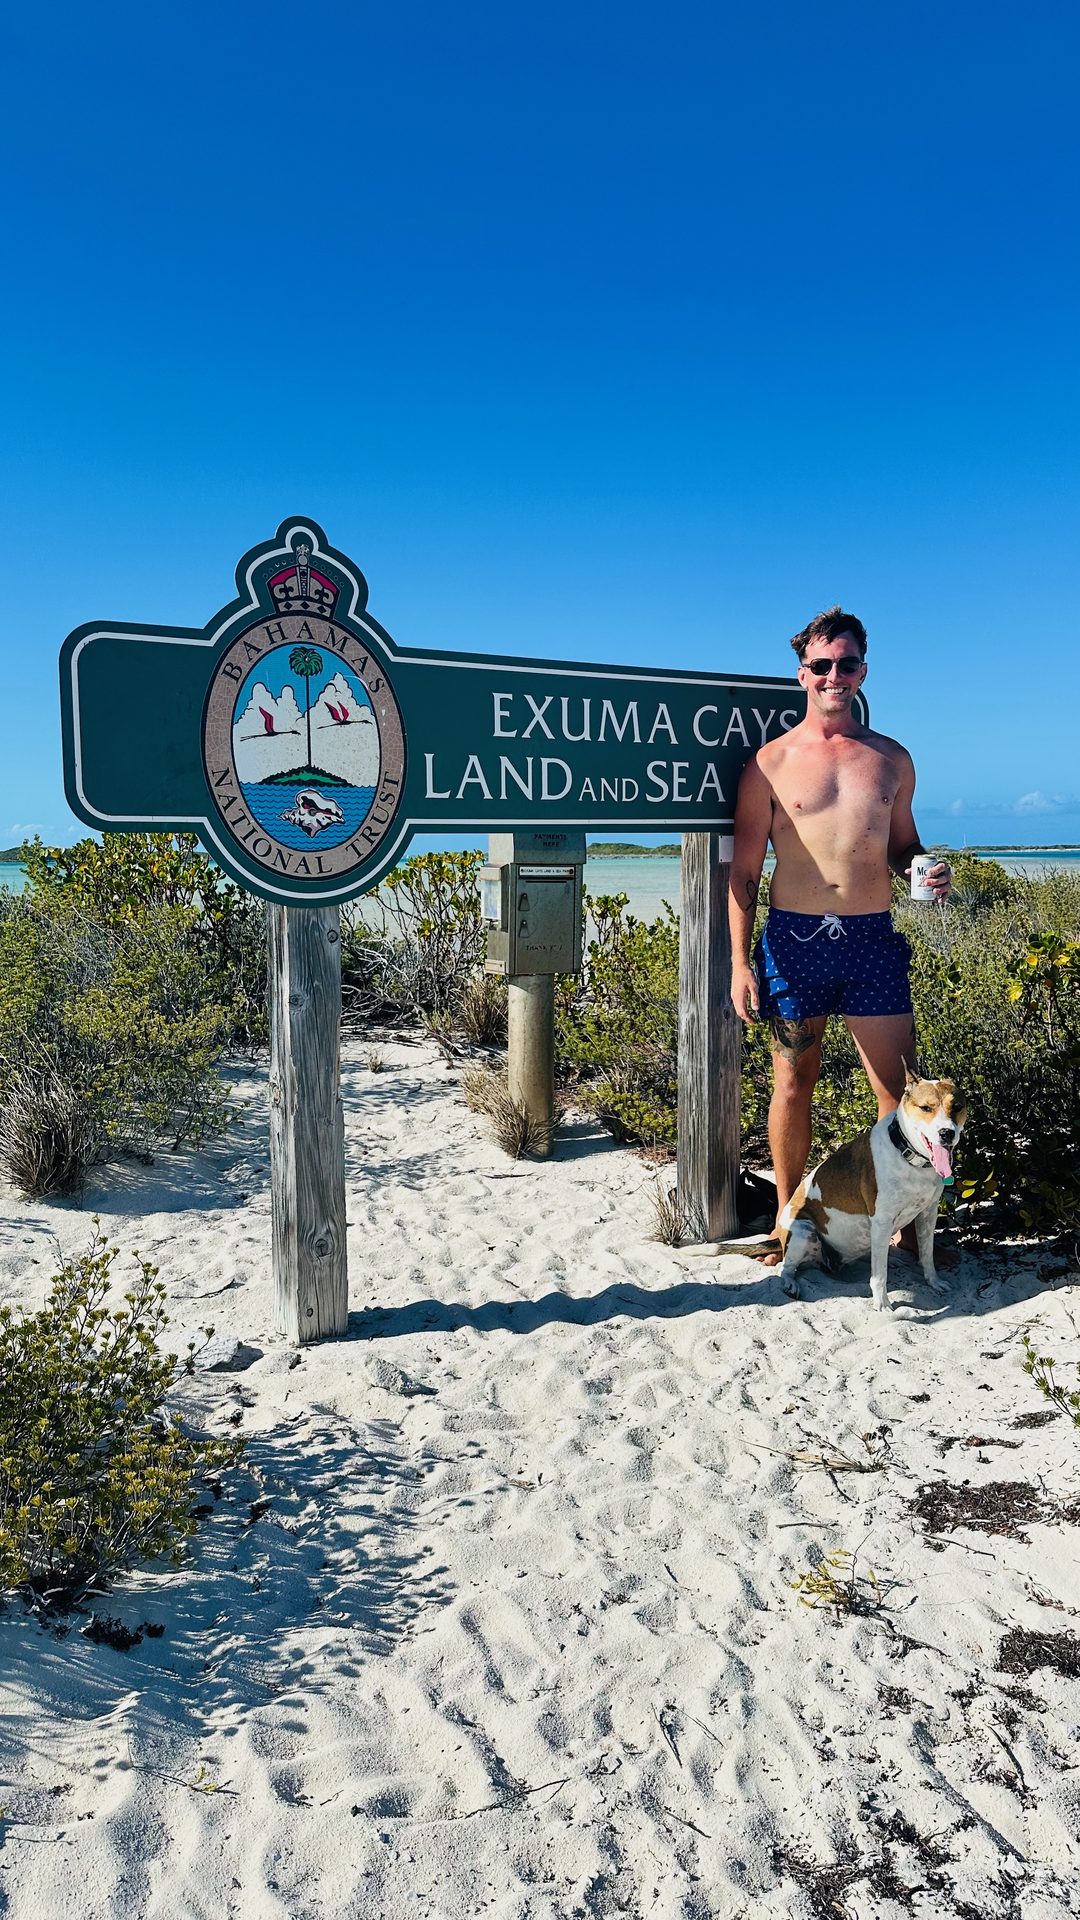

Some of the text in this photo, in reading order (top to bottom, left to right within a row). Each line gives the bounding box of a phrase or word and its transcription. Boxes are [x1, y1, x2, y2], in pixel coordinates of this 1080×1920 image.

[222, 619, 385, 695] BAHAMAS
[492, 692, 798, 748] EXUMA CAYS
[424, 753, 726, 803] LAND AND SEA
[211, 767, 400, 876] NATIONAL TRUST
